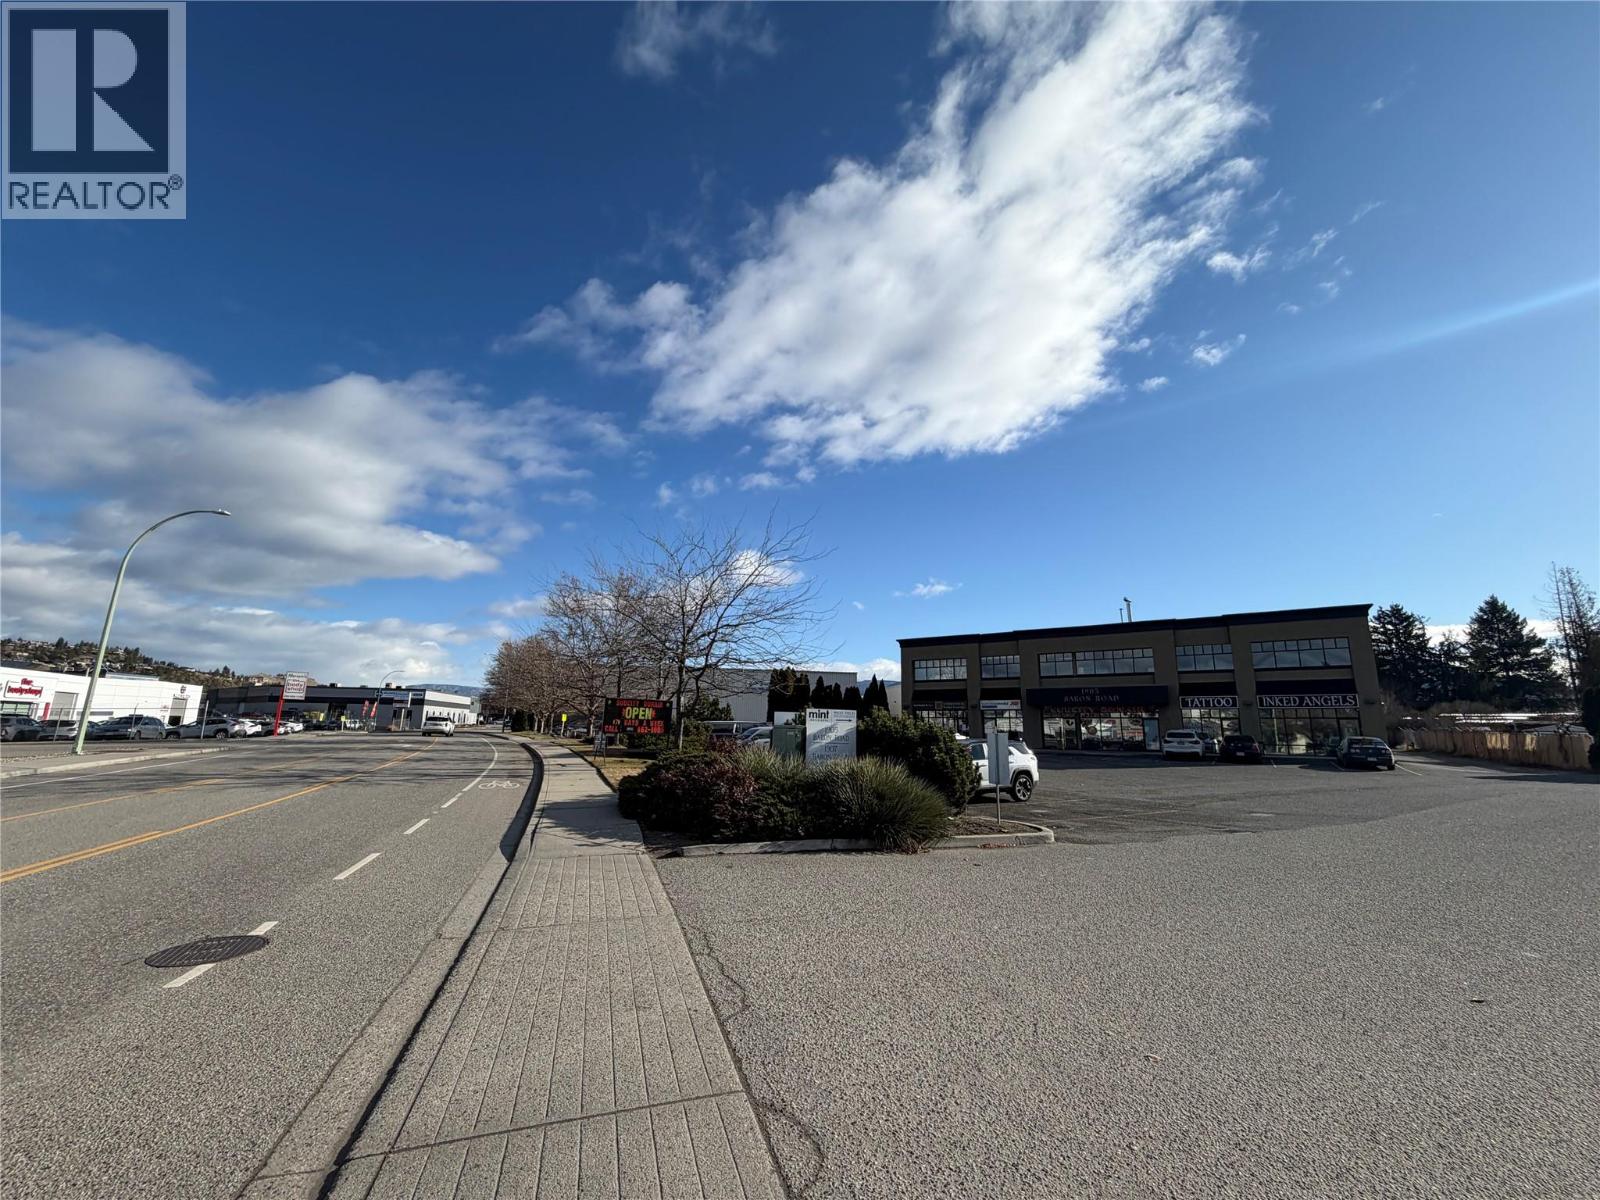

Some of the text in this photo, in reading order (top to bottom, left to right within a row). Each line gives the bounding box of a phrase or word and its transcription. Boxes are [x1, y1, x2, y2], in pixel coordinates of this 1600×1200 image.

[1185, 697, 1233, 707] TATTOO
[1263, 696, 1355, 706] INKED ANGELS
[625, 707, 653, 719] OPEN
[809, 709, 829, 719] mint
